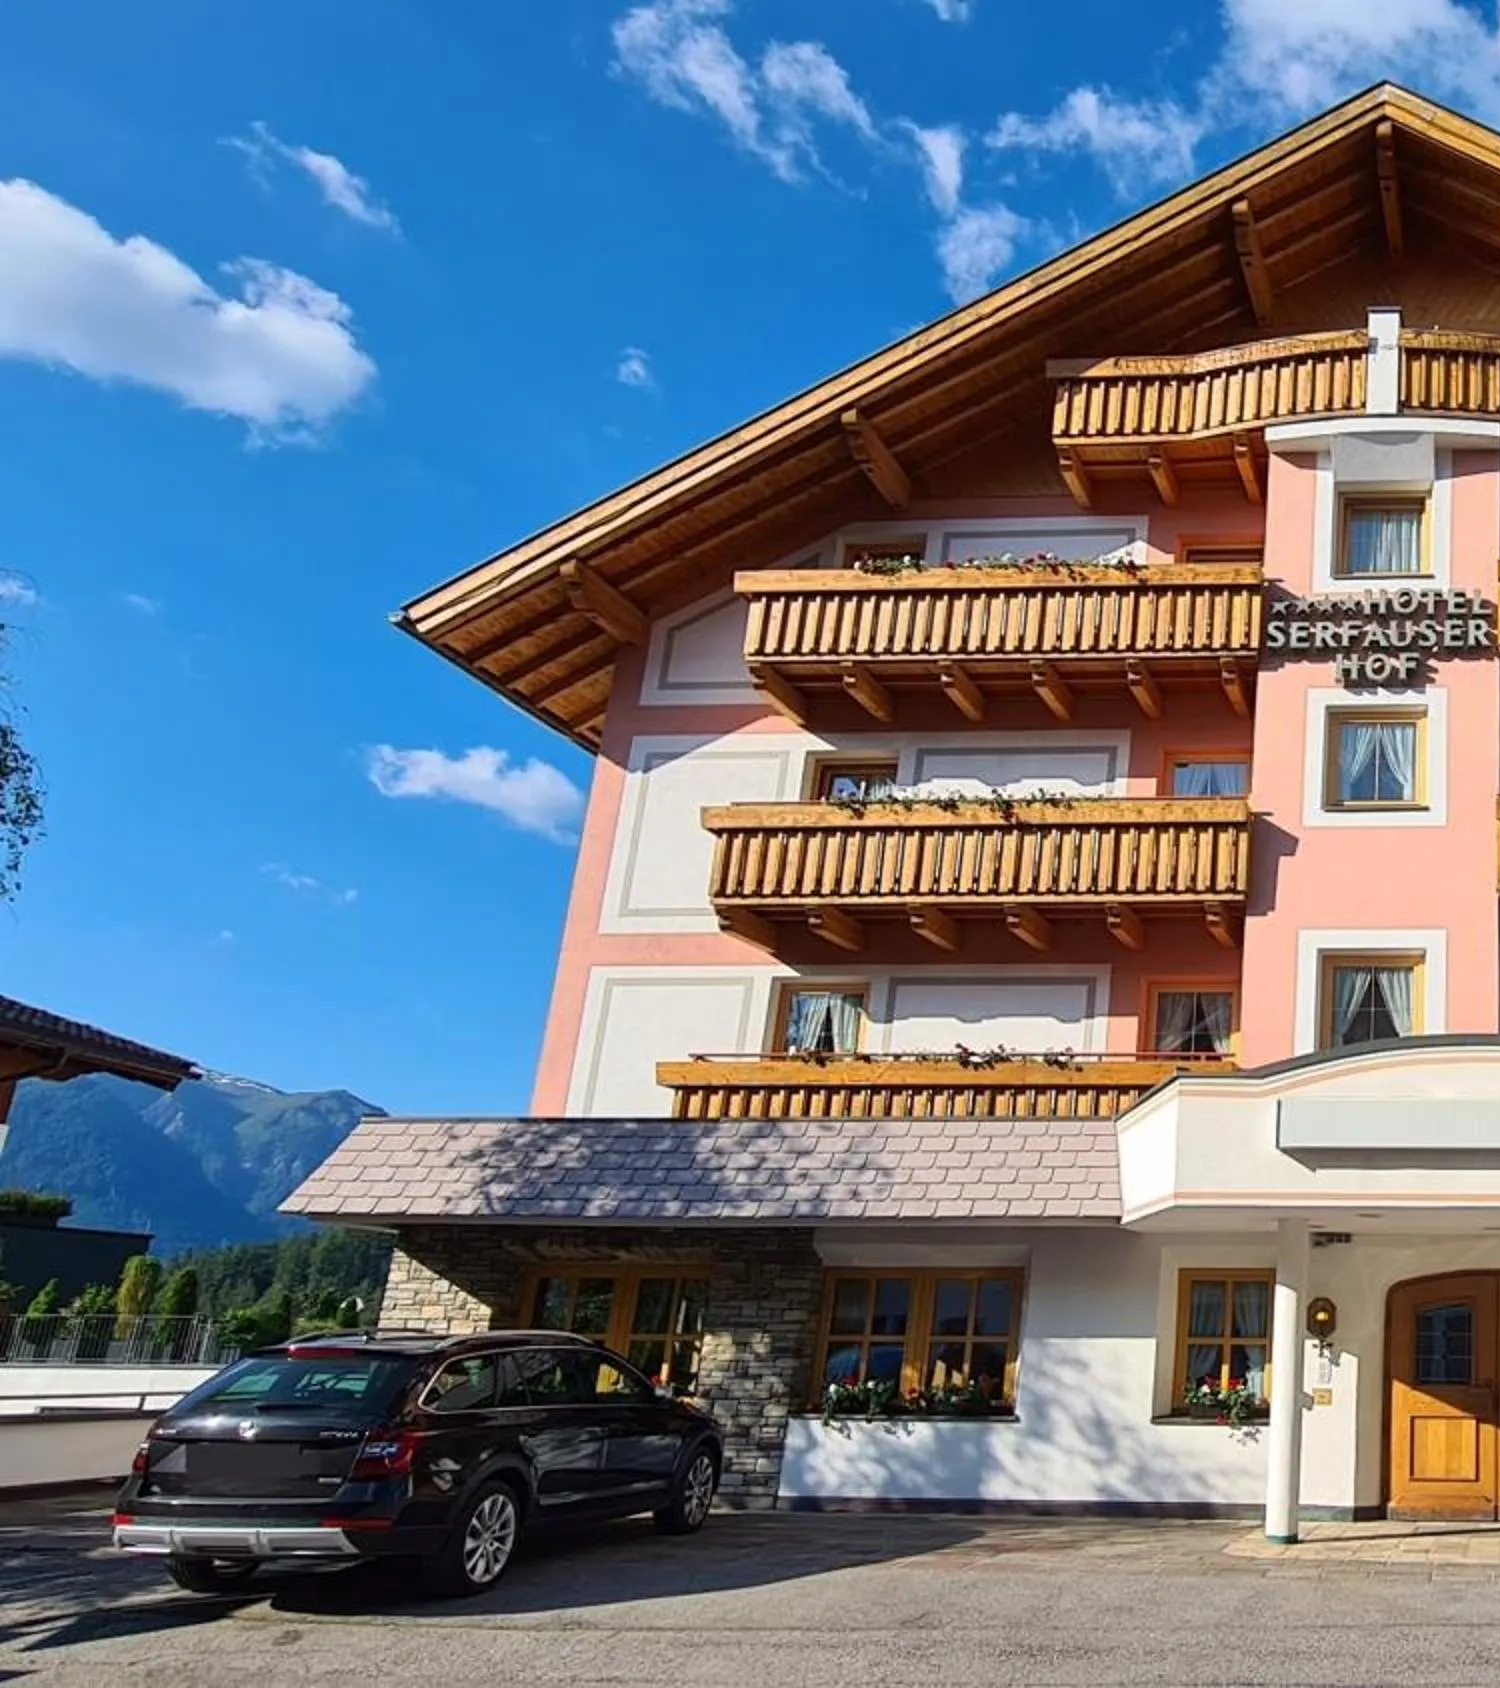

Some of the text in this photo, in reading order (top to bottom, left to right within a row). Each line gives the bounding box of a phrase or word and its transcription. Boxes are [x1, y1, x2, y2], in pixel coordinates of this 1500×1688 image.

[1364, 588, 1492, 616] HOTEL
[1267, 620, 1491, 647] SERFAUSER
[1336, 653, 1420, 681] HOF
